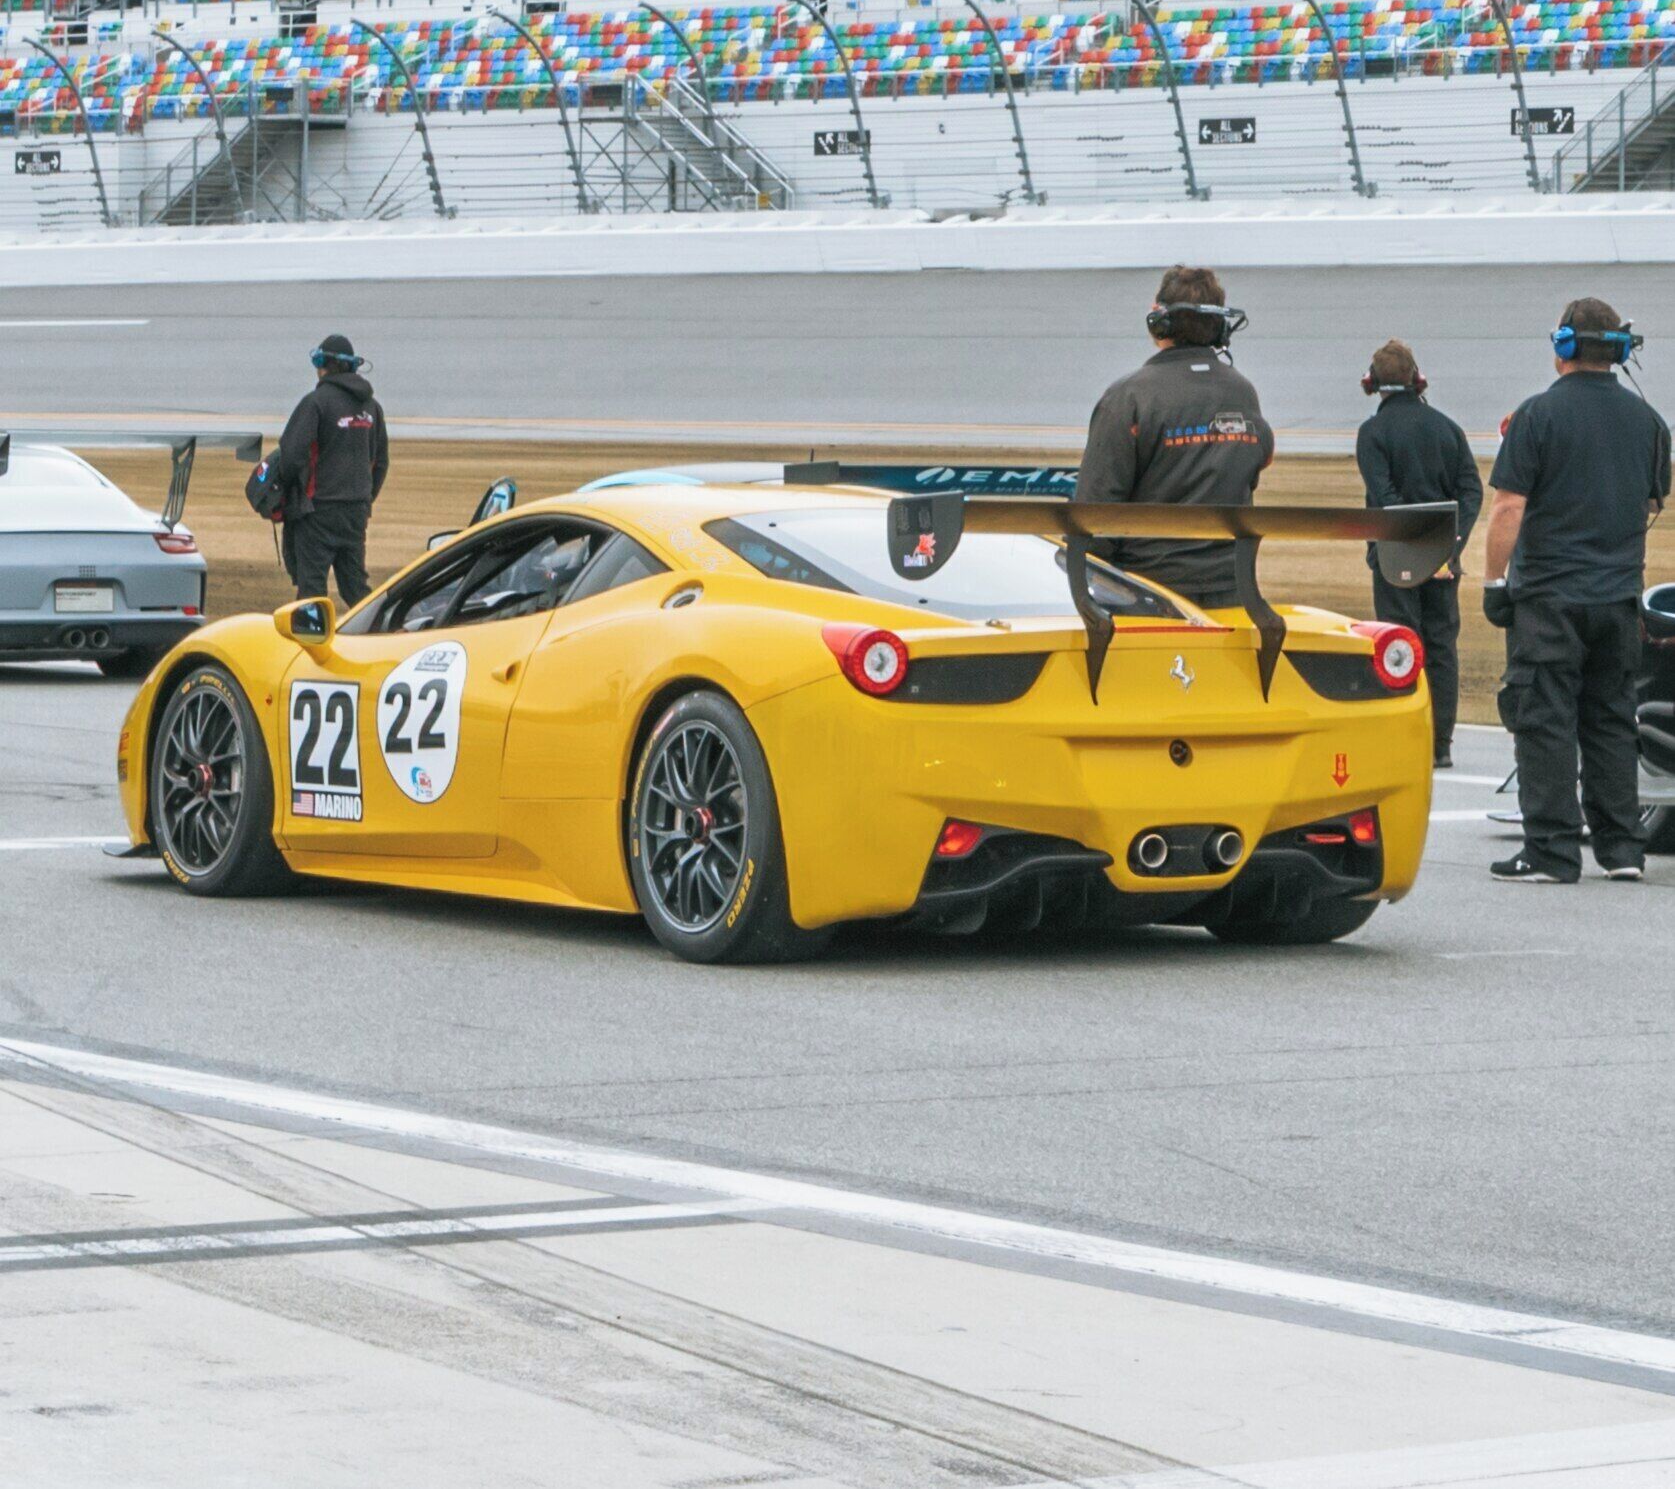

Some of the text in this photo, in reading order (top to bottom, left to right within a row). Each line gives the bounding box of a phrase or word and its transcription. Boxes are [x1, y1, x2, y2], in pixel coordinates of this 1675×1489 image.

[1166, 426, 1208, 437] TEAM
[293, 689, 358, 787] 22
[384, 678, 448, 754] 22
[314, 793, 362, 821] MARINO
